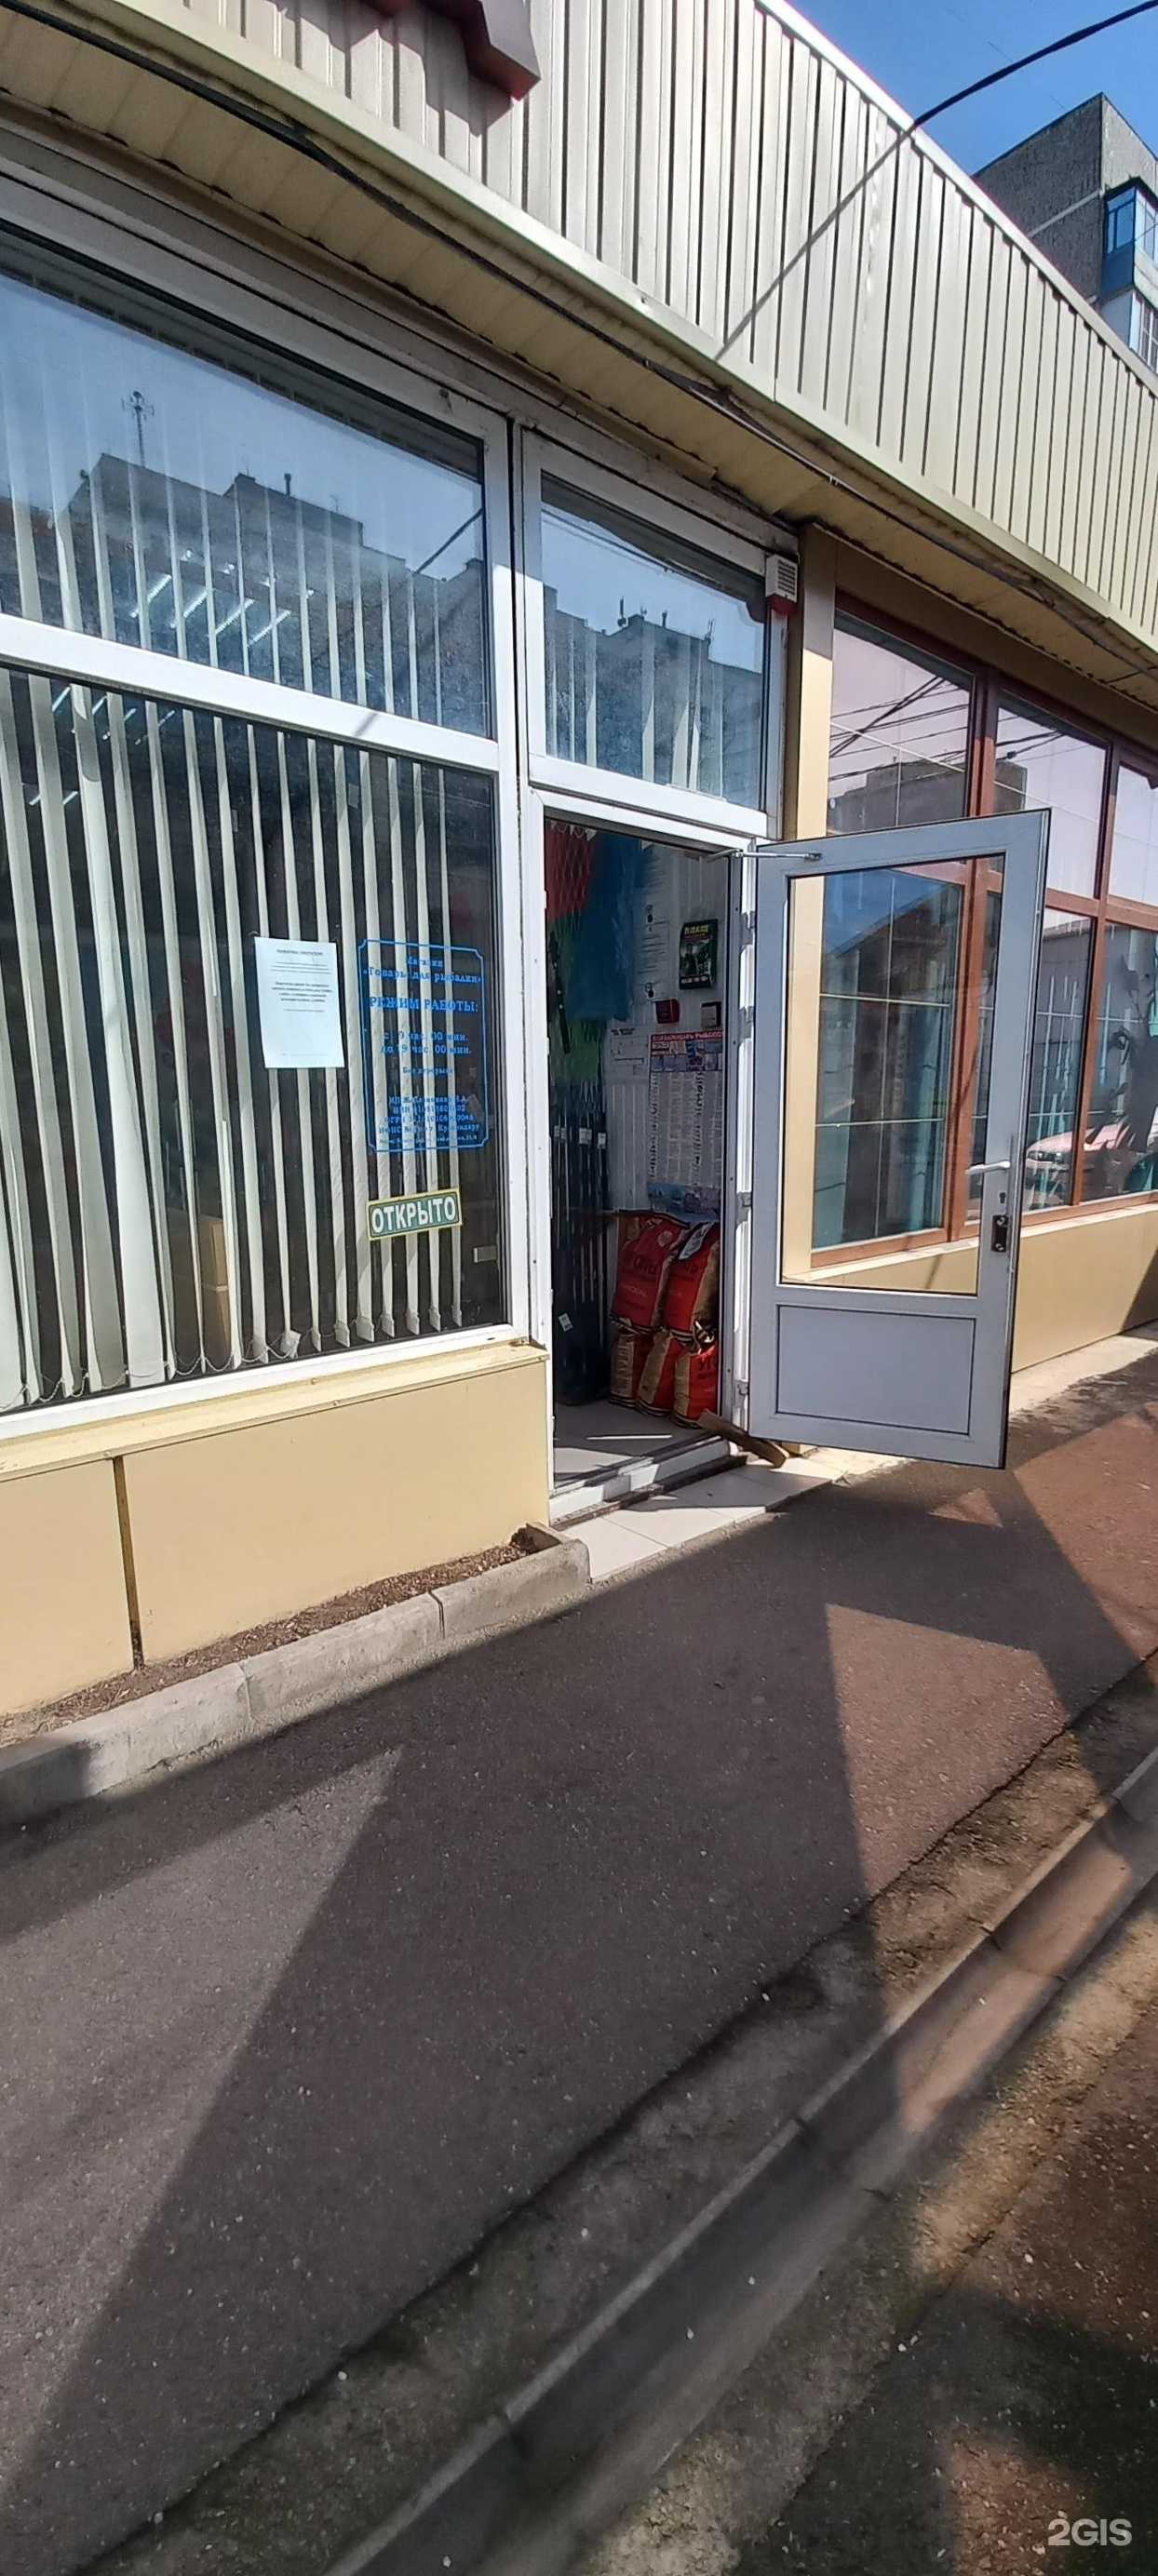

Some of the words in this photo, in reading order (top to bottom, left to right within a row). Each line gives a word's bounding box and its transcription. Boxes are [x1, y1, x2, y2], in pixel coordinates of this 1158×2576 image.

[370, 997, 419, 1009] РЕЖИМ
[424, 999, 478, 1013] РАБОТЫ:
[371, 1196, 456, 1233] ОТКРЫТО
